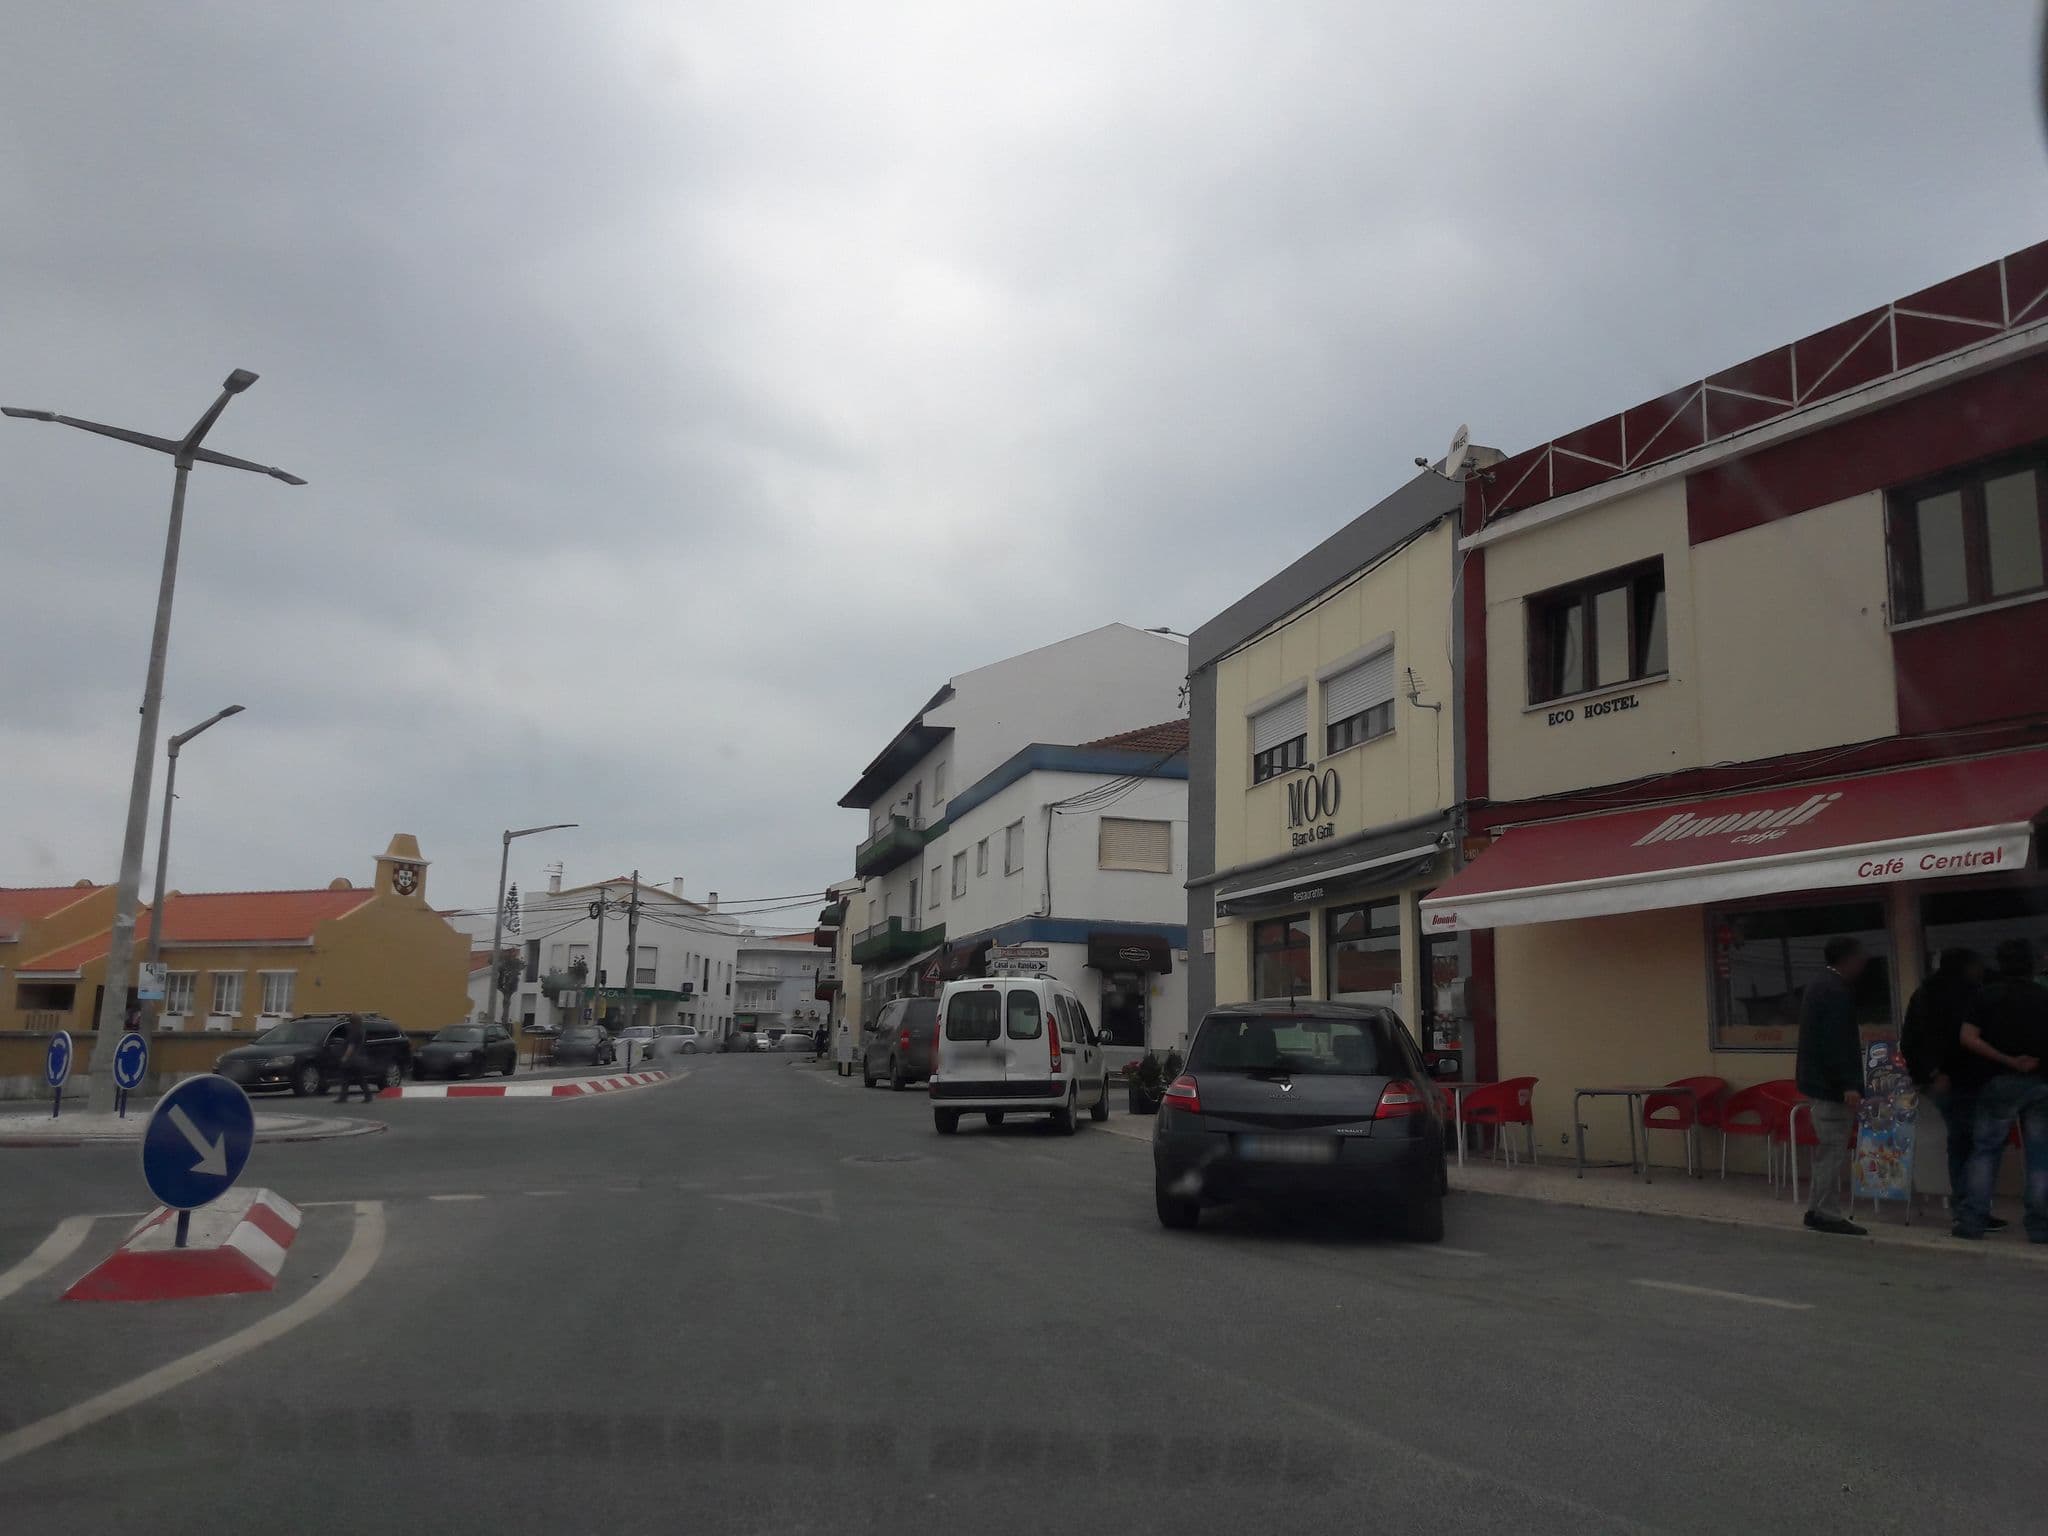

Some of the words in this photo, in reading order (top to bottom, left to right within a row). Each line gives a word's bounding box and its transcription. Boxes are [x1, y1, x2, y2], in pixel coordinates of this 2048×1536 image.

[1548, 709, 1574, 726] ECO
[1584, 694, 1639, 719] HOSTEL
[1287, 768, 1339, 829] MOO
[1292, 832, 1308, 847] Bar
[1857, 857, 1904, 878] Café
[1919, 846, 2003, 871] Central
[1293, 887, 1324, 902] Restaurante
